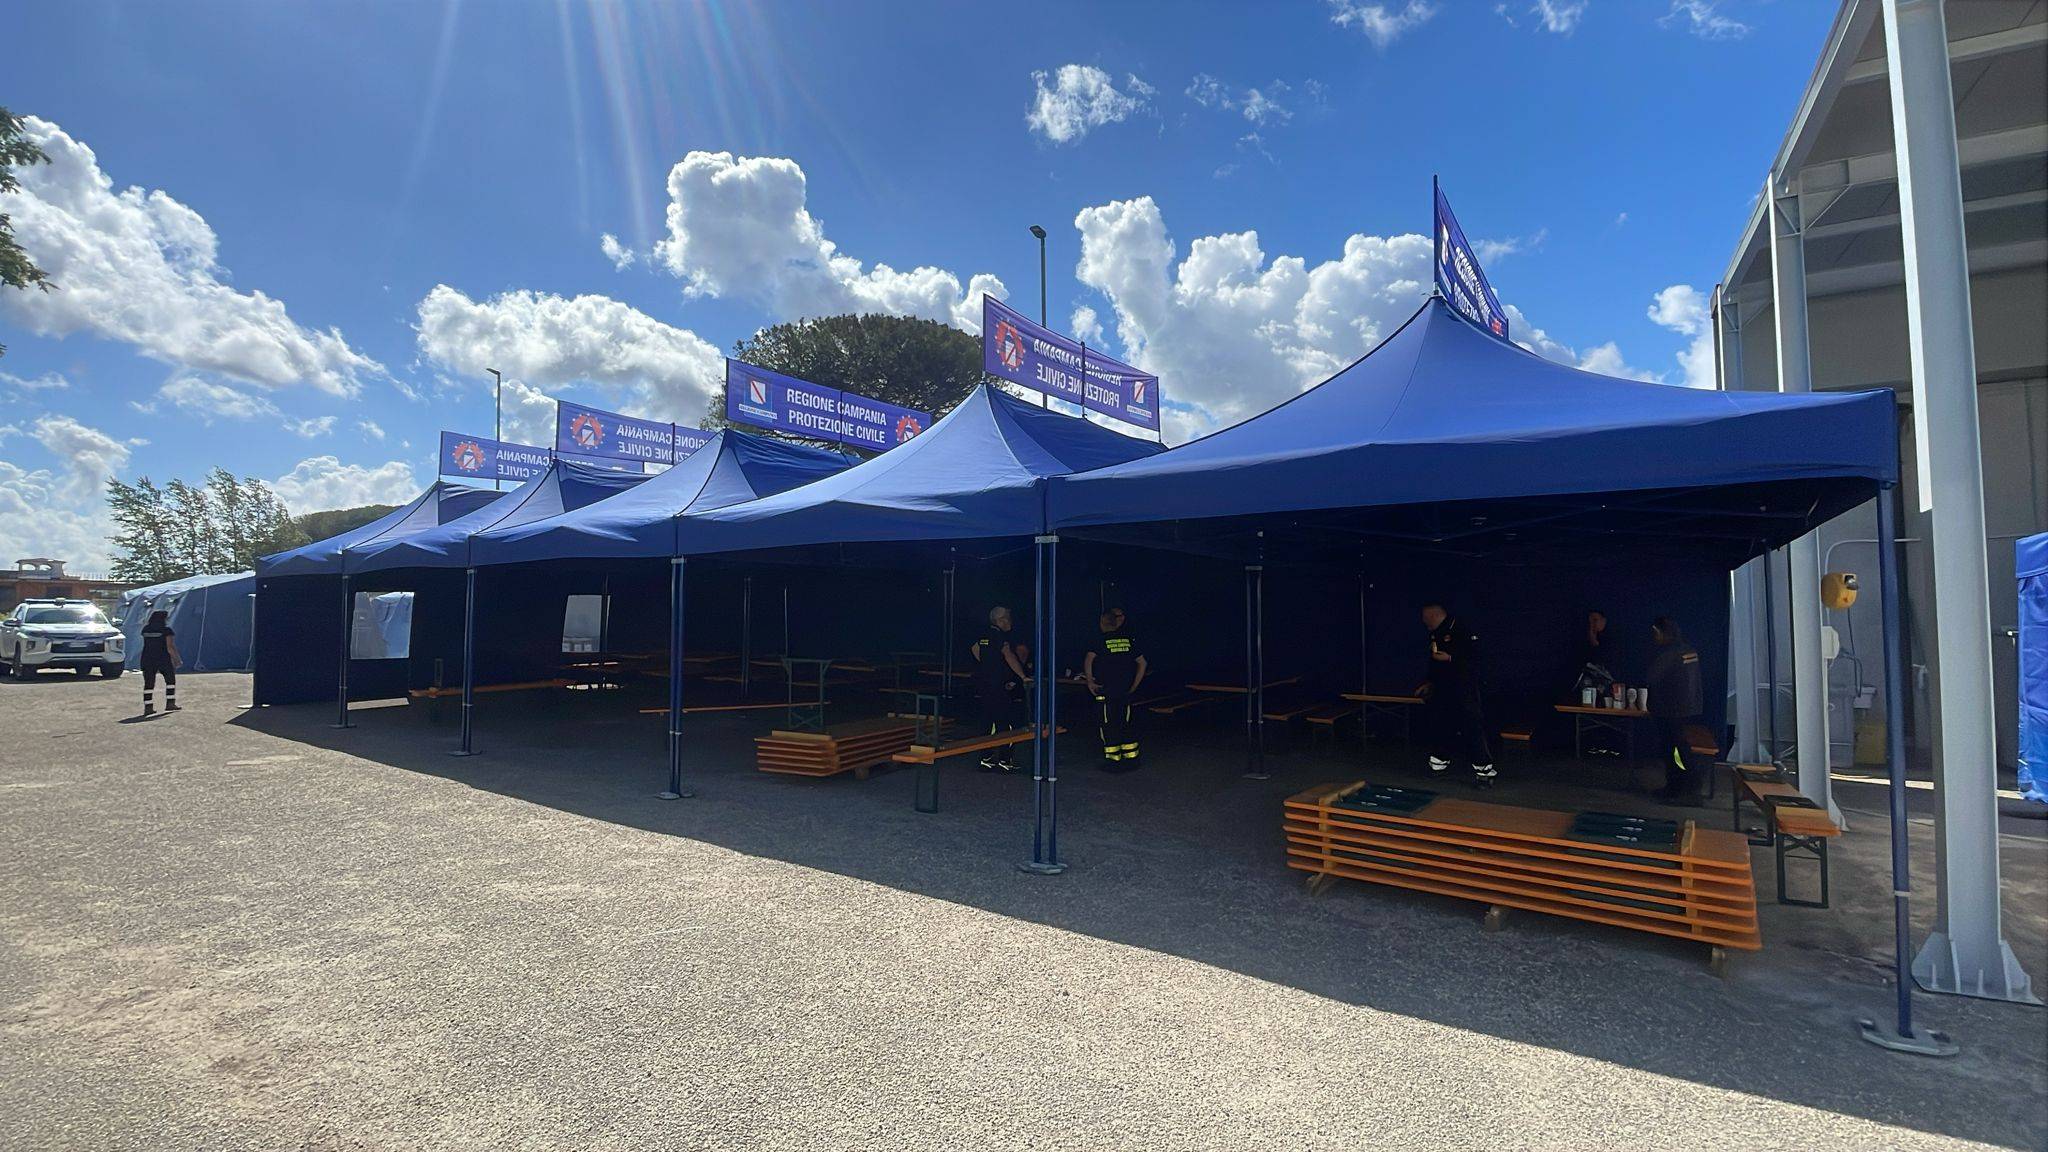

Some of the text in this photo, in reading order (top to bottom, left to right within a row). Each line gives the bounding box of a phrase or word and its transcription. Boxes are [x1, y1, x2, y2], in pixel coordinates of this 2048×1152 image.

[786, 388, 835, 413] REGIONE
[837, 400, 887, 426] CAMPANIA
[788, 409, 854, 437] PROTEZIONE
[856, 426, 886, 444] CIVILE
